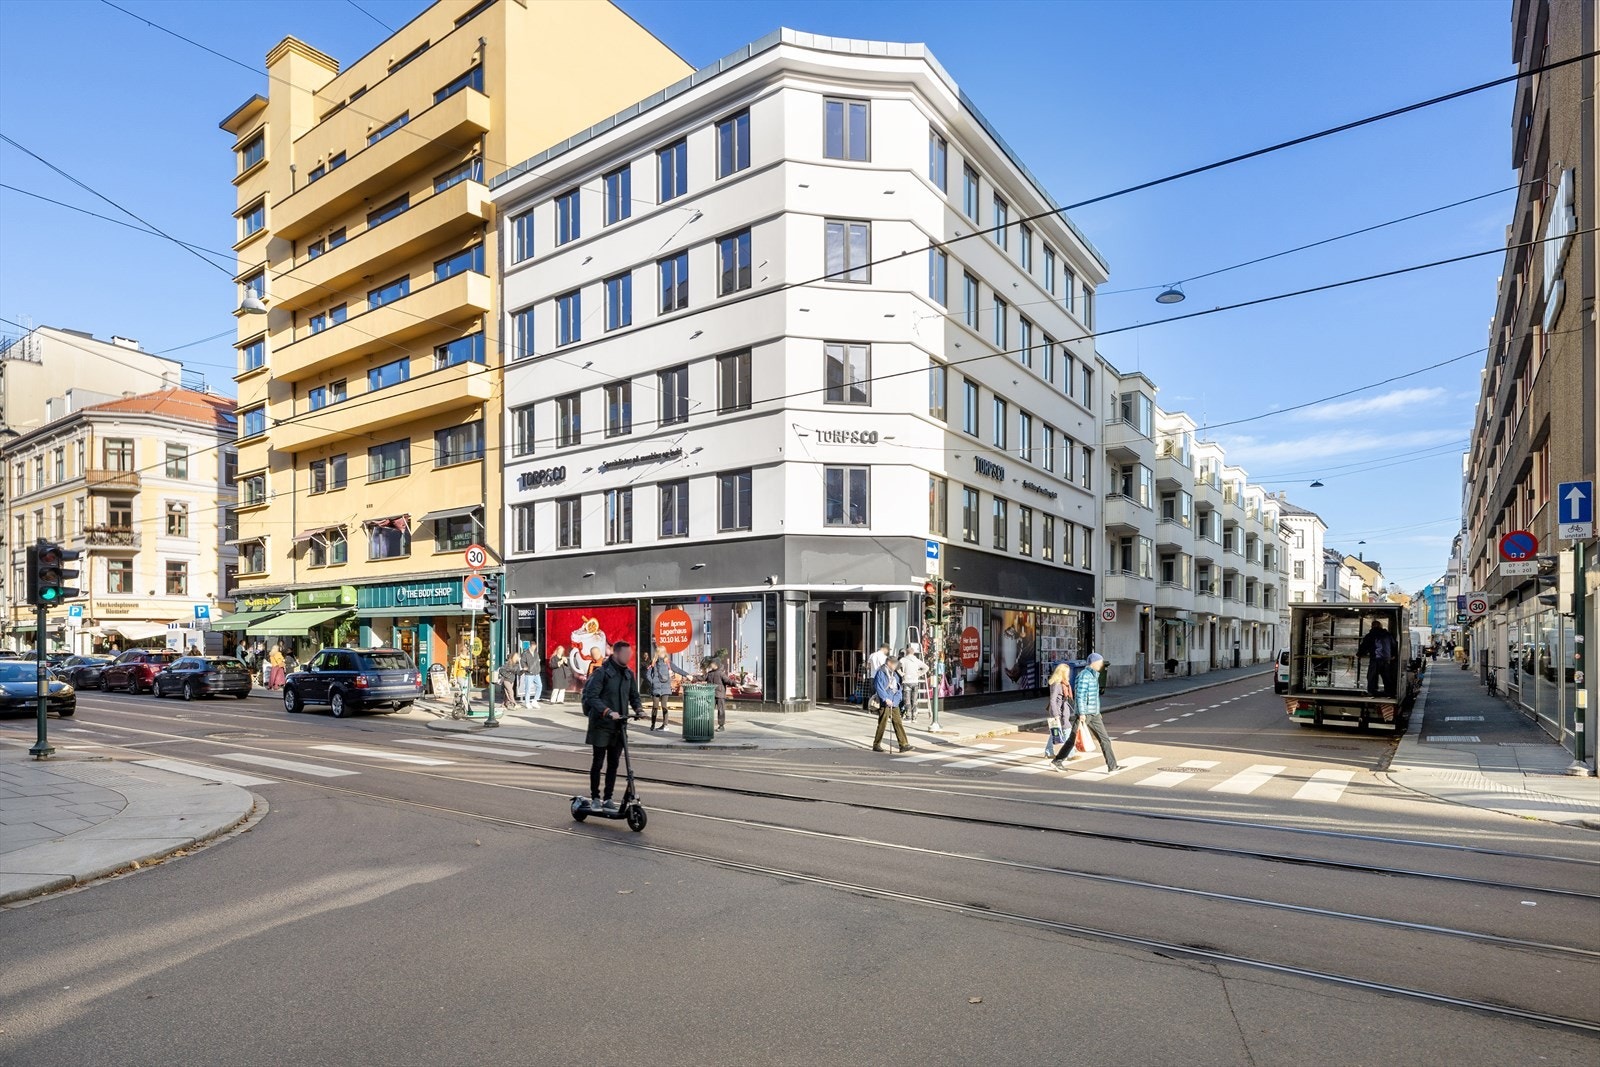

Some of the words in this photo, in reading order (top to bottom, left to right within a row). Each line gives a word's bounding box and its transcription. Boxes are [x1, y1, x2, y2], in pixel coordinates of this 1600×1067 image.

[815, 429, 879, 444] TORP&CO
[974, 455, 1005, 481] TORP&CO
[520, 465, 566, 486] TORP&CO
[469, 550, 483, 564] 30
[406, 590, 419, 599] THE
[418, 588, 433, 598] BODY
[434, 587, 453, 597] SHOP
[71, 608, 80, 616] P
[197, 606, 207, 618] P
[1472, 602, 1484, 611] 30
[670, 619, 687, 628] åpner
[659, 628, 687, 636] Lagerhaus
[659, 636, 674, 644] 30.10
